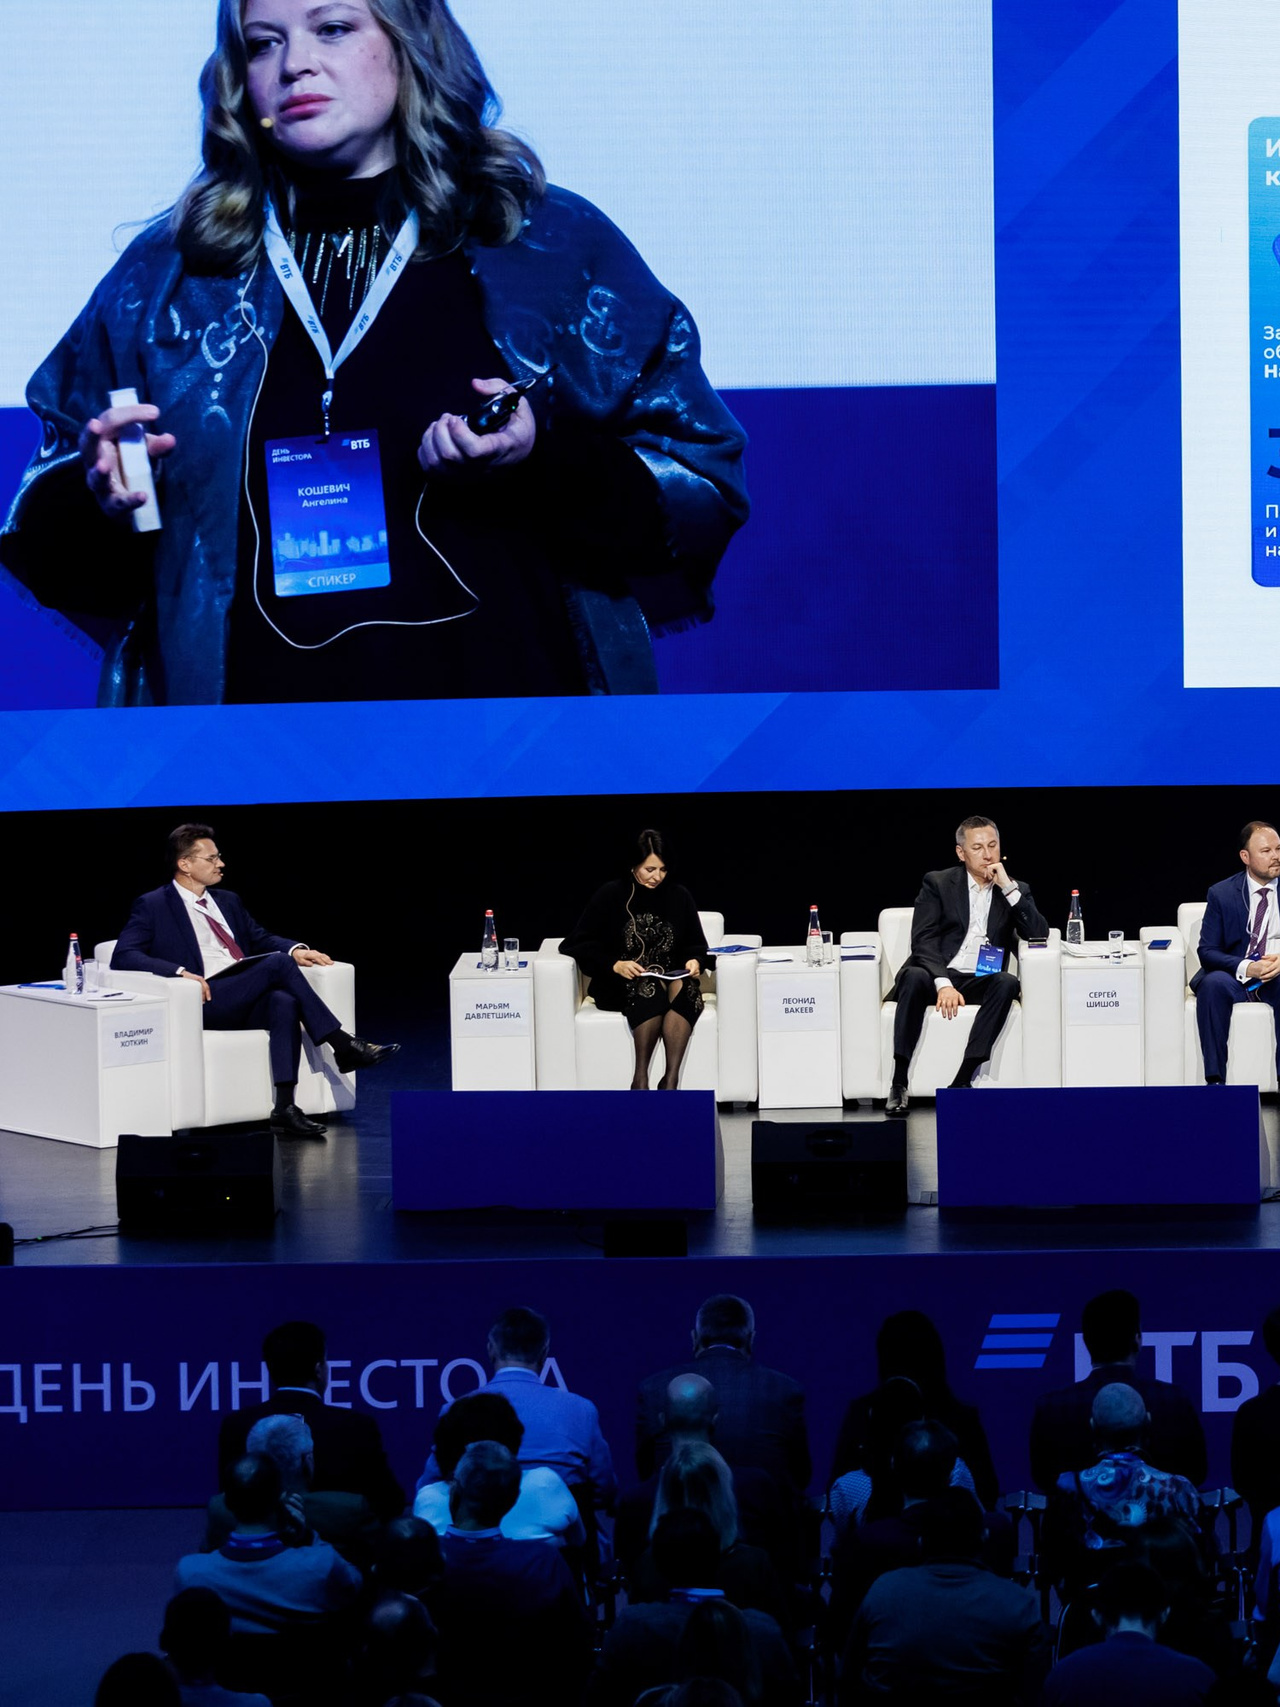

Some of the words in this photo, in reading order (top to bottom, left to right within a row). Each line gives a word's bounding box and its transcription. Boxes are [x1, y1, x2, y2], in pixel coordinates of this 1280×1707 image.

[351, 439, 370, 450] ВТБ
[272, 453, 312, 463] ИНВЕСТОРА
[298, 483, 350, 496] КОШЕВИЧ
[302, 497, 348, 508] Ангелина
[1266, 525, 1277, 538] и
[308, 573, 356, 588] СПИКЕР
[1089, 990, 1117, 998] СЕРГЕЙ
[465, 1012, 521, 1020] ДАВЛЕТШИНА
[114, 1028, 153, 1039] ВЛАДИМИР
[1074, 1331, 1259, 1412] ТБ
[180, 1356, 570, 1412] ИНЕСТОА
